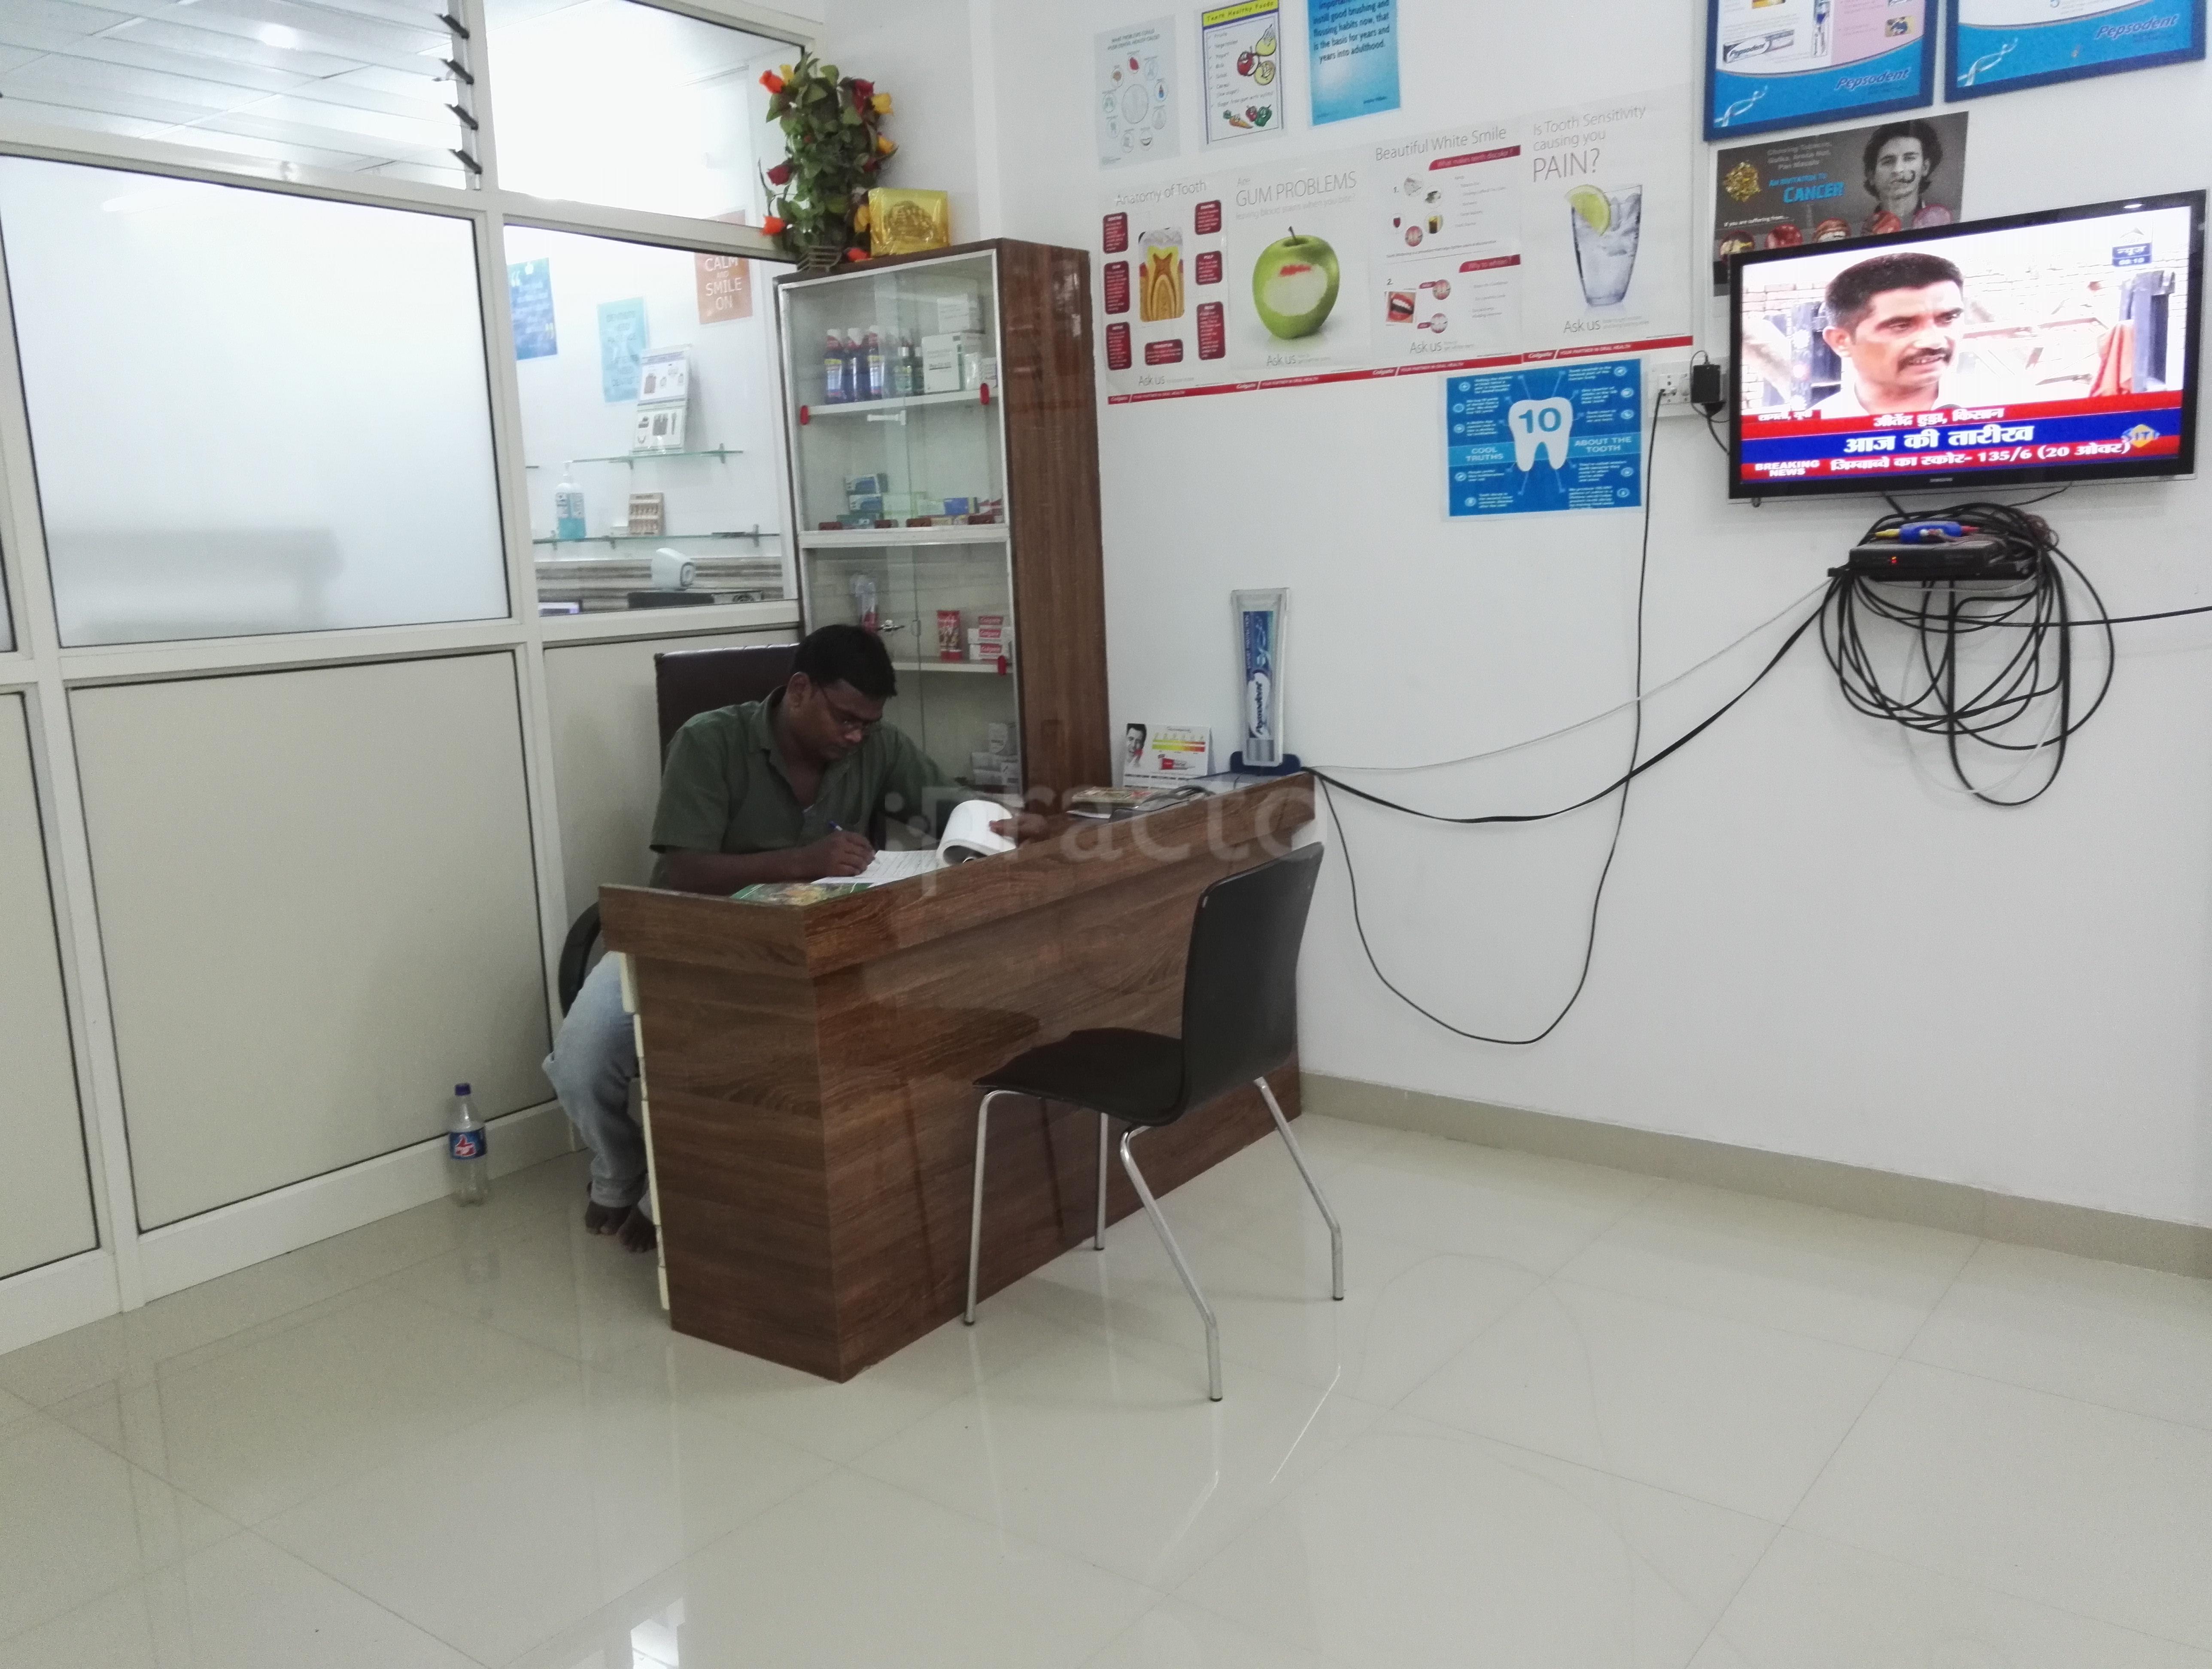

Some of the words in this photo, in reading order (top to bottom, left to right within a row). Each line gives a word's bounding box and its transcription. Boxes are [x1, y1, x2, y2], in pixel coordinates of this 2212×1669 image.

[1331, 9, 1347, 22] good
[1348, 3, 1376, 16] brushing
[1377, 0, 1390, 9] and
[1339, 21, 1358, 31] habits
[1376, 12, 1390, 22] that
[1320, 39, 1330, 49] the
[1331, 37, 1348, 46] basis
[1360, 30, 1377, 42] years
[1378, 24, 1390, 35] and
[2092, 13, 2180, 40] Pepsodent
[1319, 52, 1336, 64] years
[1337, 49, 1350, 58] into
[1351, 39, 1386, 55] adulthood.
[1834, 67, 1911, 91] Pepsodent
[1533, 123, 1543, 136] Is
[1544, 116, 1580, 134] Tooth
[1583, 106, 1646, 127] Sensitivity
[1375, 138, 1428, 161] Beautiful
[1431, 134, 1468, 151] White
[1471, 126, 1507, 145] Smile
[1533, 134, 1580, 152] causing
[1582, 130, 1606, 147] you
[1533, 147, 1601, 183] PAIN?
[1116, 190, 1162, 206] Anatomy
[1164, 184, 1176, 198] of
[1177, 180, 1206, 196] Tooth
[1236, 185, 1272, 207] GUM
[1276, 170, 1358, 200] PROBLEMS
[1783, 181, 1845, 204] CANCER
[705, 255, 739, 272] CALM
[705, 277, 742, 297] SMILE
[716, 295, 733, 310] ON
[1563, 319, 1585, 334] Ask
[1586, 320, 1602, 331] us
[1410, 341, 1428, 355] Ask
[1429, 342, 1442, 352] us
[1267, 353, 1282, 367] Ask
[1518, 407, 1563, 434] 10
[1952, 407, 2005, 422] किसान
[1574, 438, 1610, 447] ABOUT
[1586, 445, 1622, 453] TOOTH
[1843, 435, 1896, 453] आज
[1903, 428, 1940, 449] की
[1948, 423, 2036, 446] तारीख
[1754, 459, 1820, 471] BREAKING
[1893, 456, 1918, 467] का
[1978, 446, 2033, 462] 135/6
[2036, 445, 2071, 460] (20
[2073, 442, 2132, 456] ओवर)
[1768, 467, 1806, 477] NEWS
